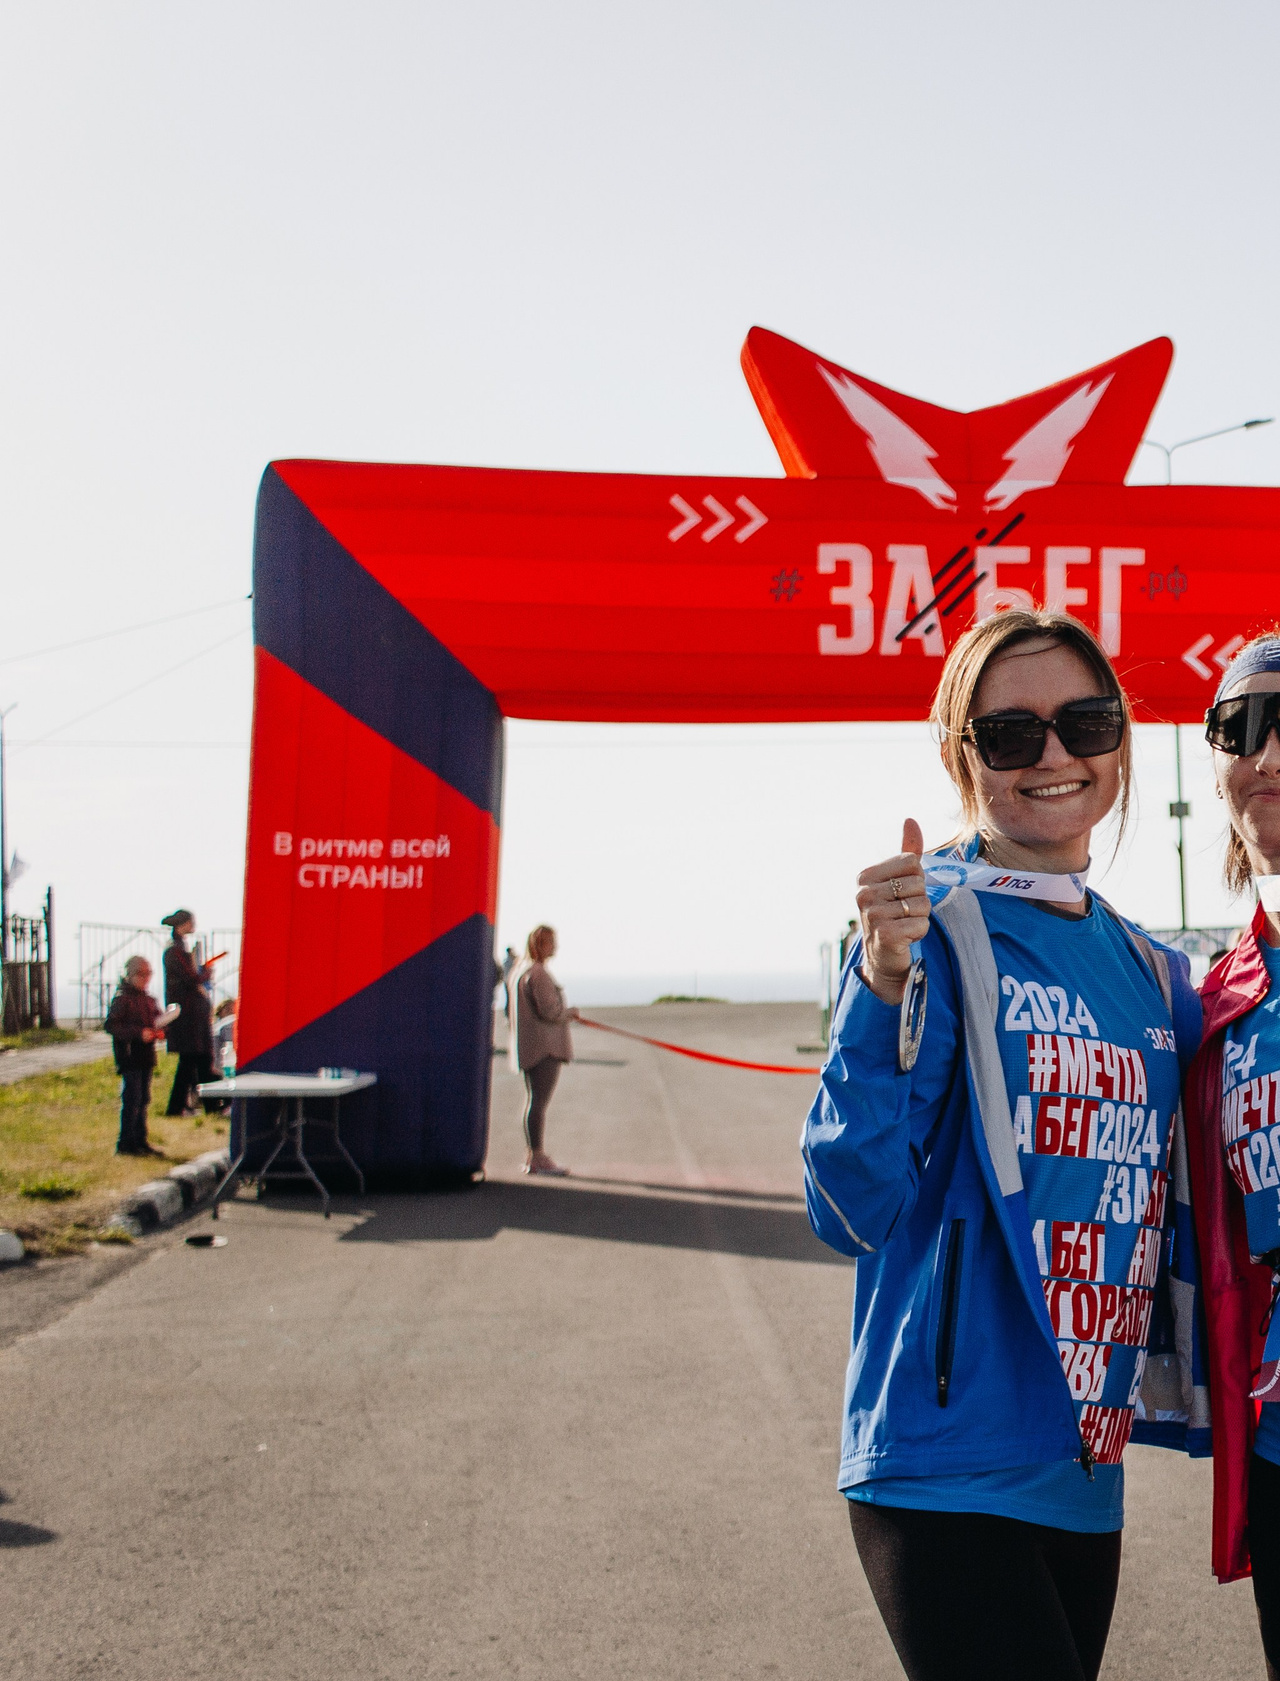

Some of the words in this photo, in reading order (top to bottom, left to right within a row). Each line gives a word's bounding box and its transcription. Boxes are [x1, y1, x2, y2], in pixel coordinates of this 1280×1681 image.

[273, 831, 293, 855] В
[300, 838, 384, 859] ритме
[390, 834, 450, 858] всей
[298, 863, 424, 889] СТРАНЫ!
[1005, 878, 1036, 889] ПСБ
[1001, 975, 1100, 1038] 2024
[1027, 1034, 1147, 1105] #МЕЧТА
